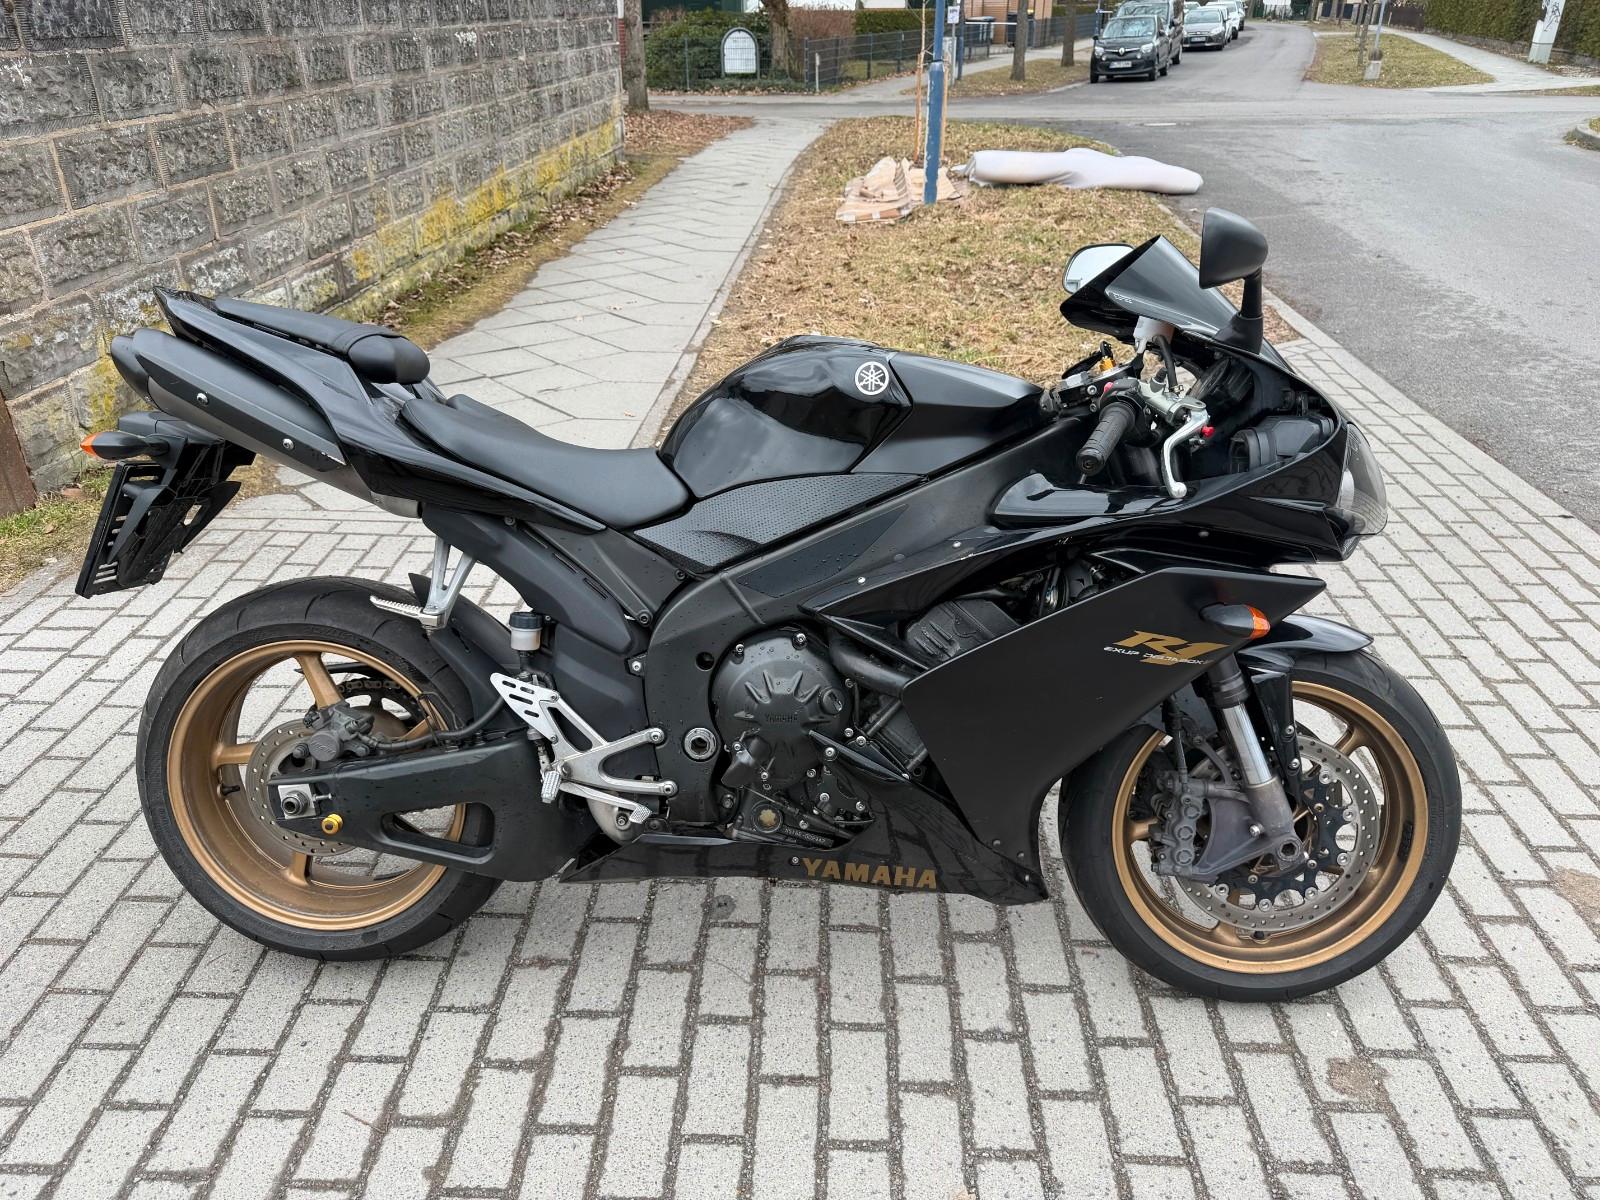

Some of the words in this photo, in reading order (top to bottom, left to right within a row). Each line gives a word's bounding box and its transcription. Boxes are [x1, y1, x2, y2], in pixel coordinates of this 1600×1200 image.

[1103, 646, 1140, 656] EXUP
[1112, 630, 1230, 666] R1
[802, 857, 937, 889] YAMAHA
